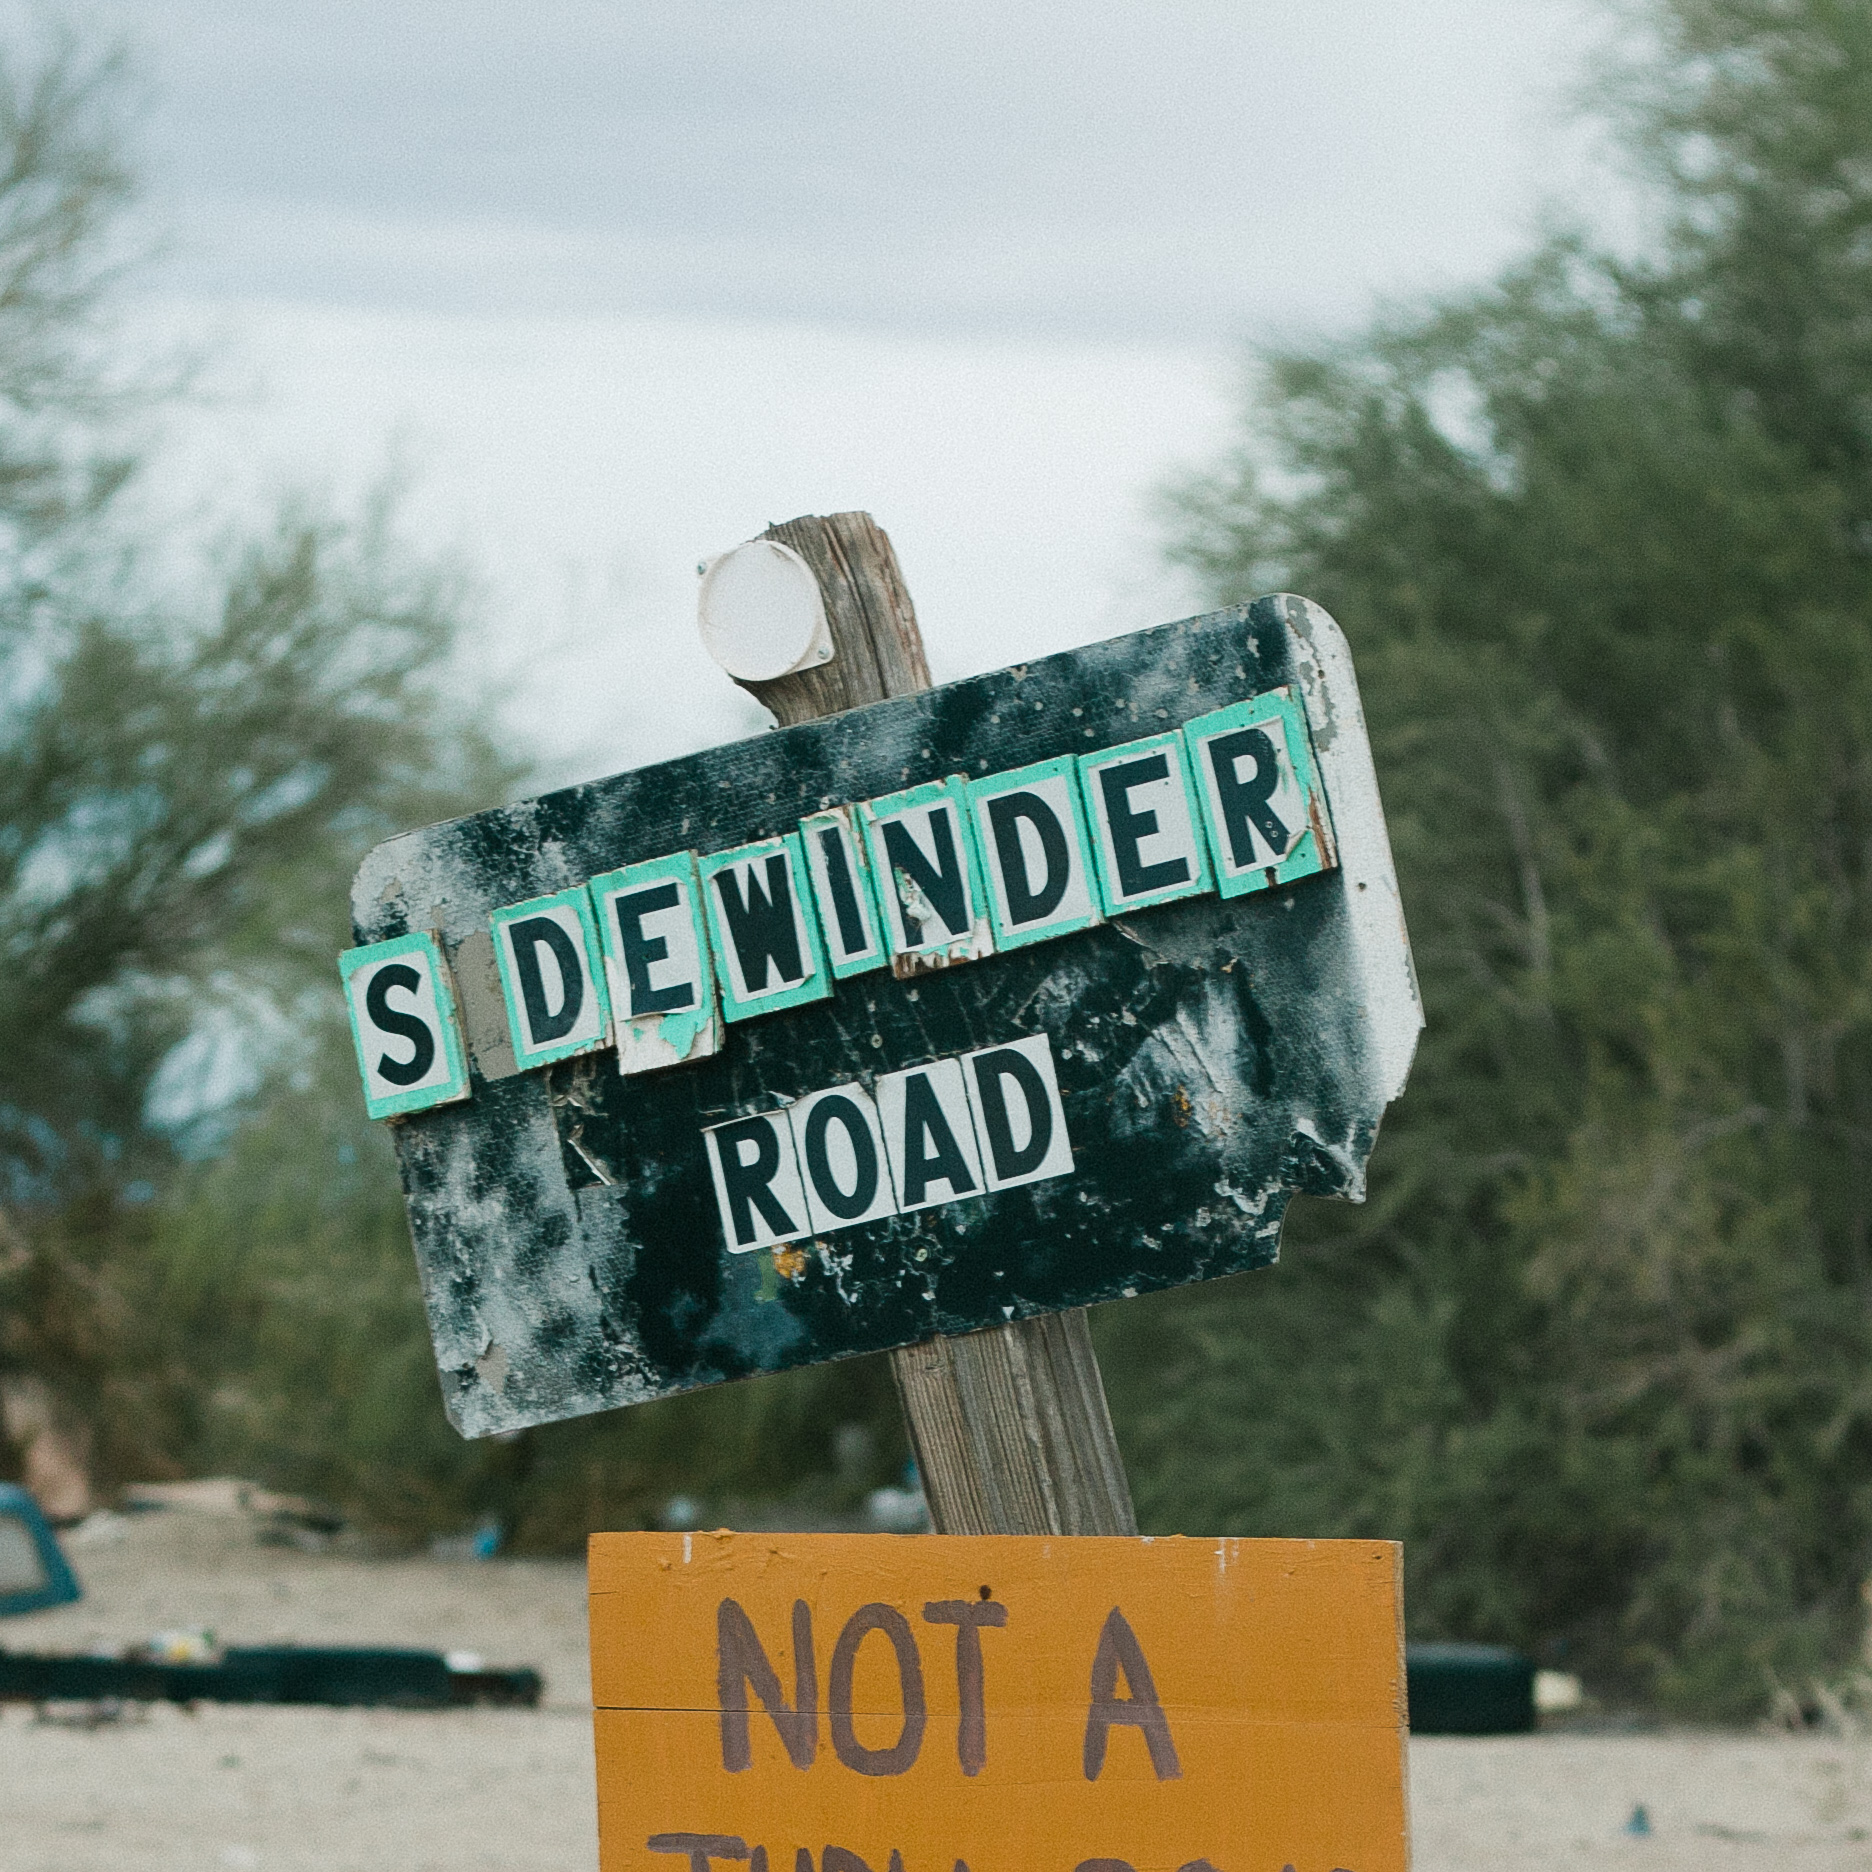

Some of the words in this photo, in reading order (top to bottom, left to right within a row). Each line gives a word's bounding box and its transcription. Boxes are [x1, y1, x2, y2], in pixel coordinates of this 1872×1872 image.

[362, 728, 1290, 1088] SDEWINDER
[720, 1048, 1055, 1247] ROAD
[717, 1597, 1007, 1777] NOT
[1082, 1606, 1183, 1781] A
